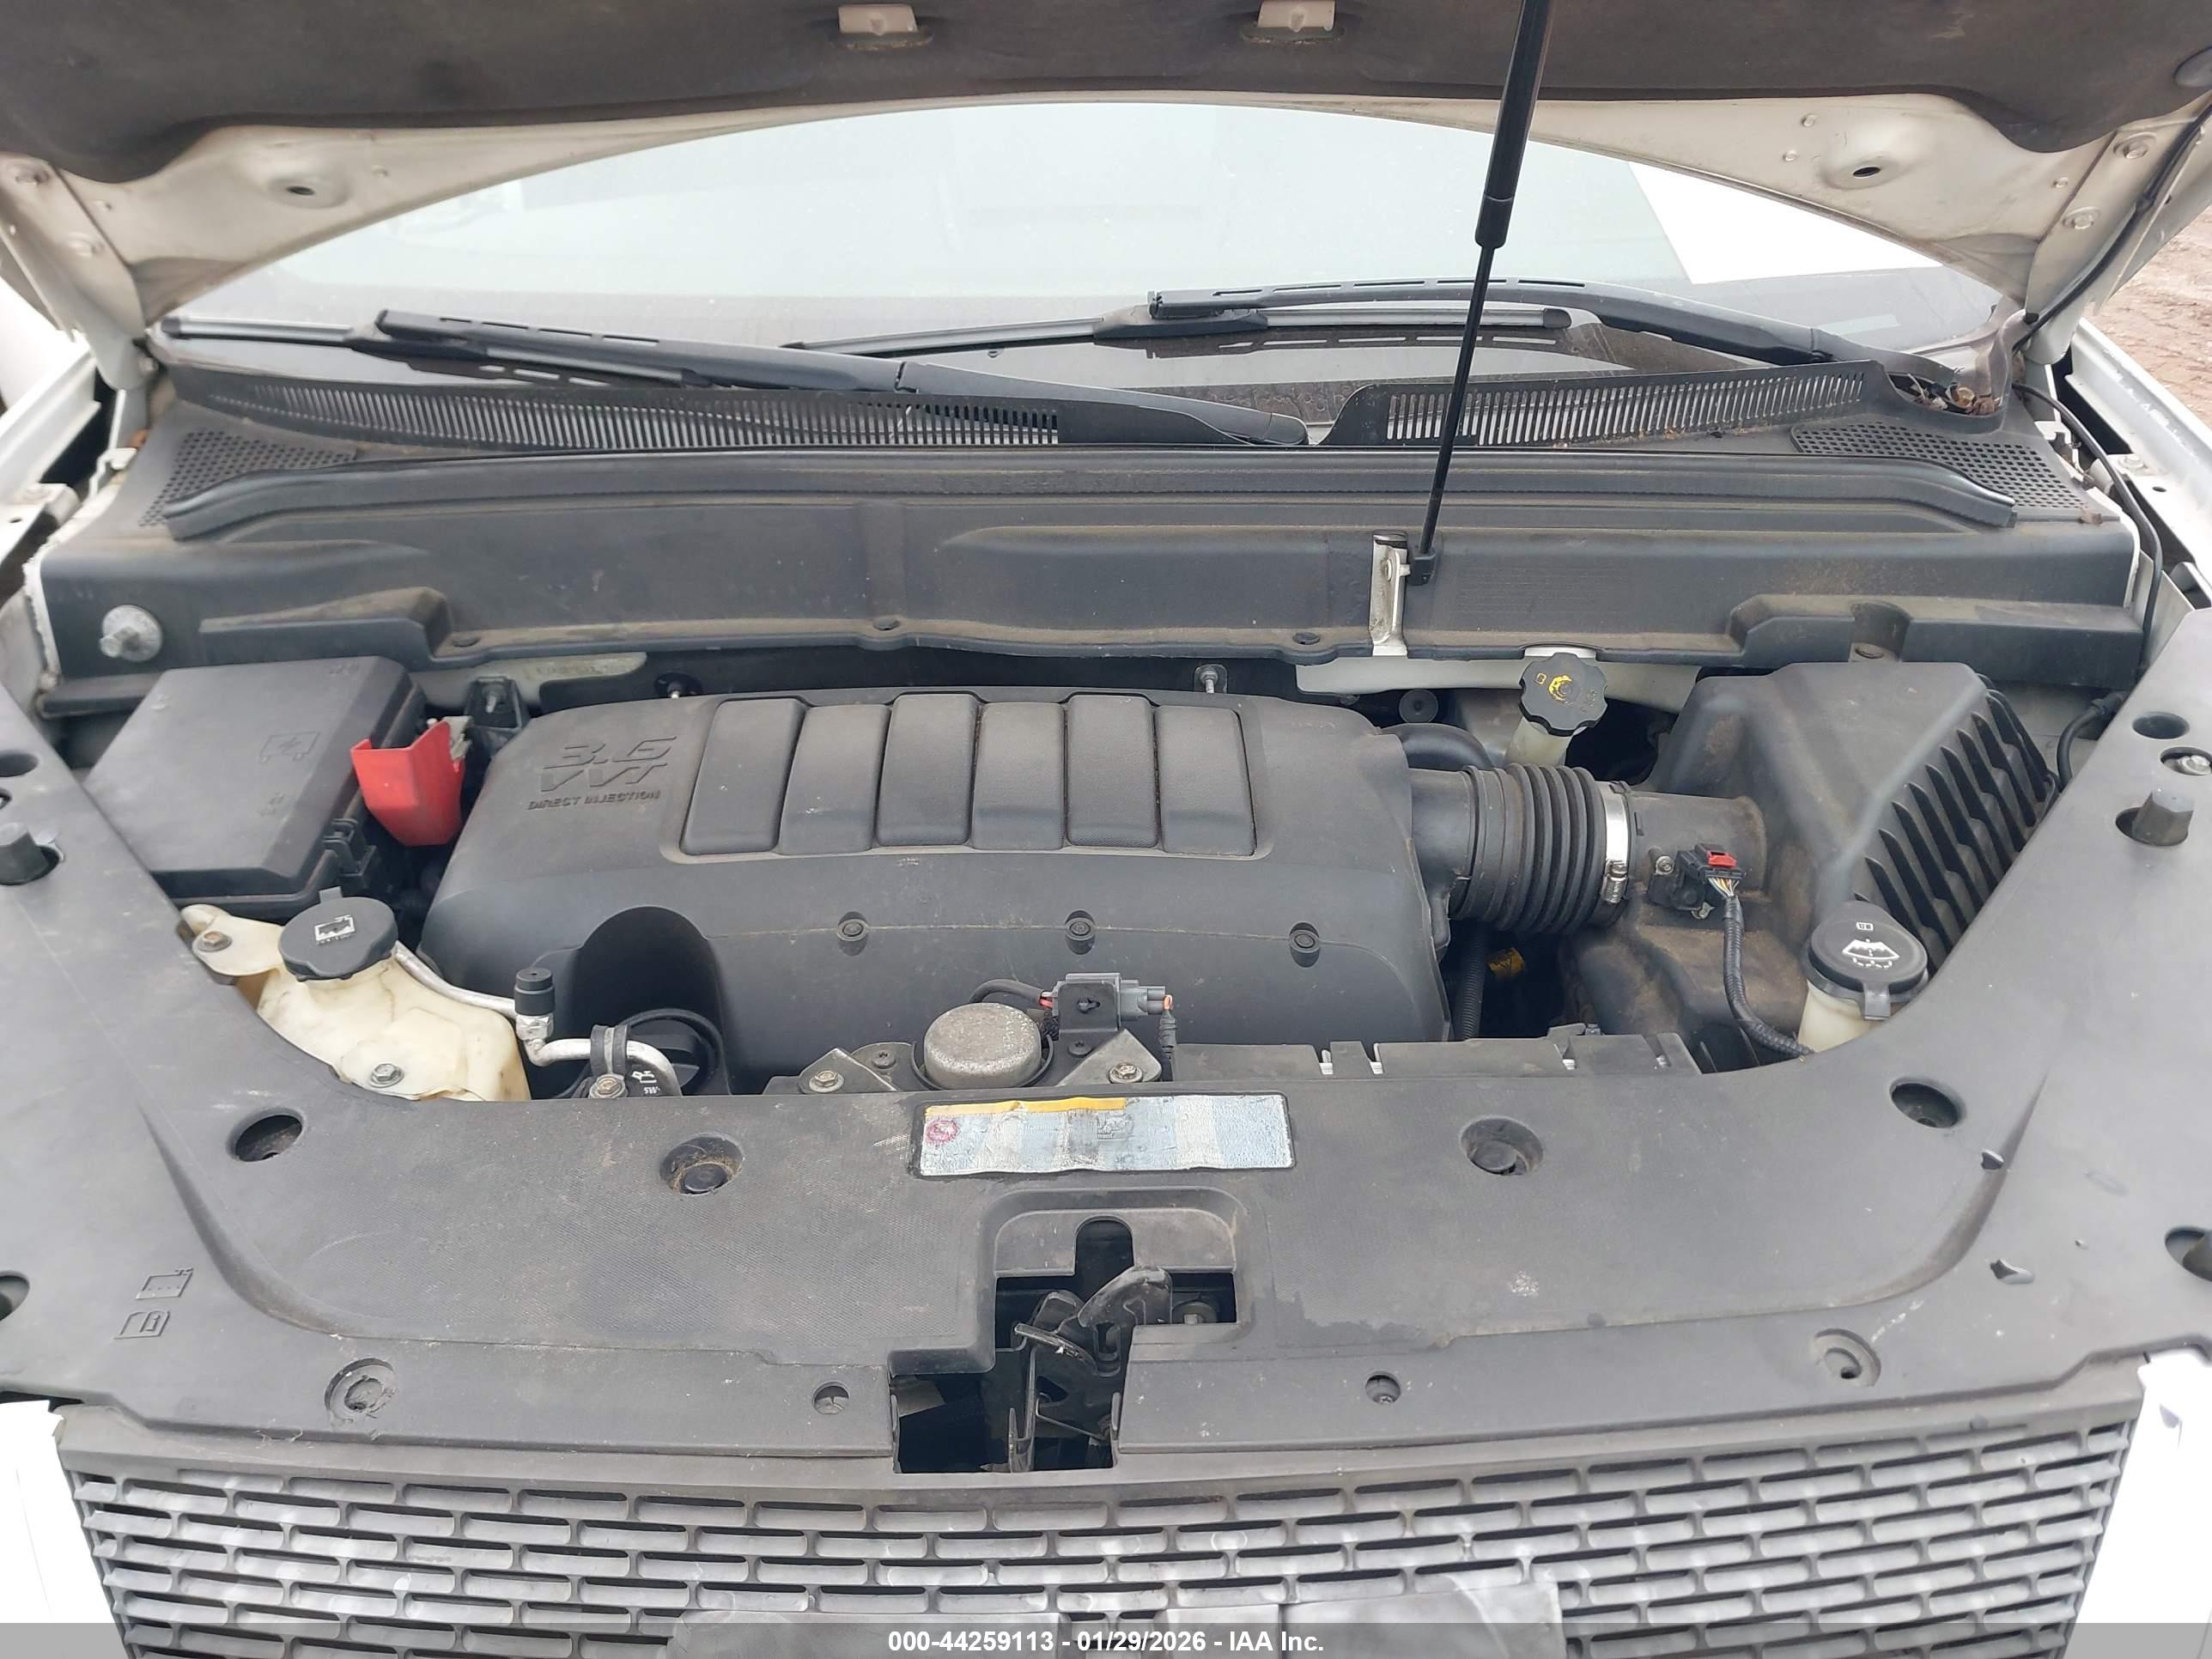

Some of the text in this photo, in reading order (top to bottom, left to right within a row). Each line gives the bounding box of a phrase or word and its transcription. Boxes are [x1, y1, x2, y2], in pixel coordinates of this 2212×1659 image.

[543, 735, 678, 770] 3.6
[540, 763, 668, 793] VVT
[528, 789, 661, 811] DIRECT INJECTION
